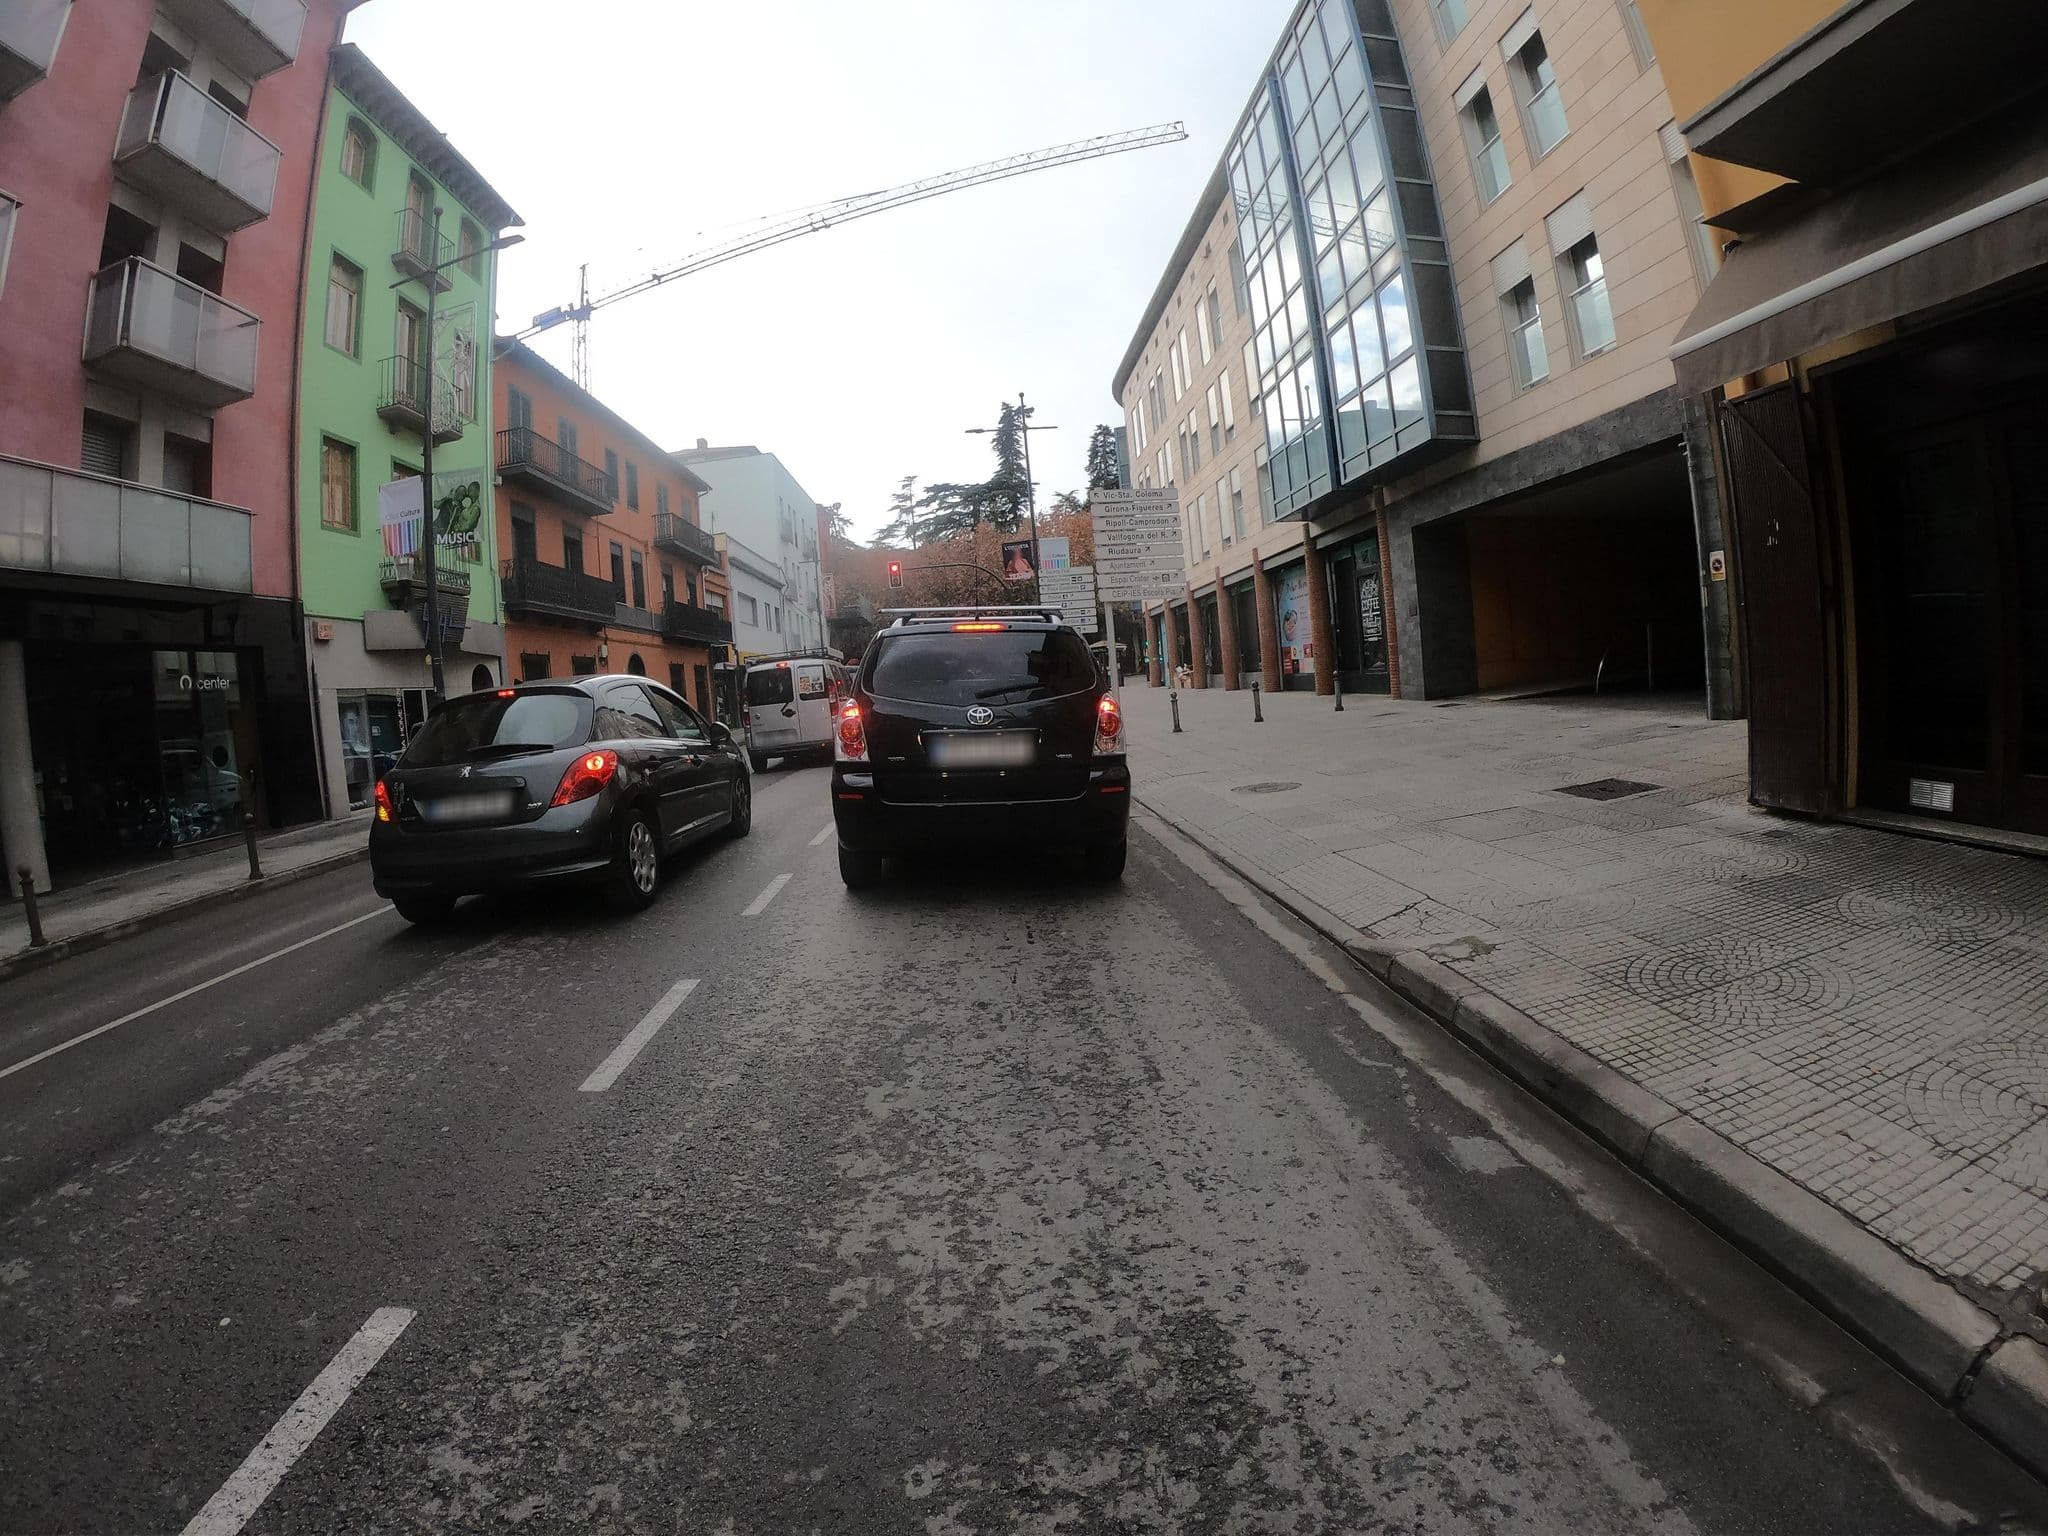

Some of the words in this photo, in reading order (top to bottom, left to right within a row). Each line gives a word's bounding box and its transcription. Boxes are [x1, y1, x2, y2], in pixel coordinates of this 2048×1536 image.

[1135, 490, 1163, 498] Coloma
[1104, 504, 1164, 513] Girona-Figueres
[1105, 518, 1169, 527] Ripoll-Camprodon
[1107, 533, 1144, 541] Vallfogona
[1108, 547, 1142, 555] Riudaura
[1110, 561, 1146, 570] Ajuntament
[1143, 588, 1164, 596] Escola
[196, 677, 230, 690] center
